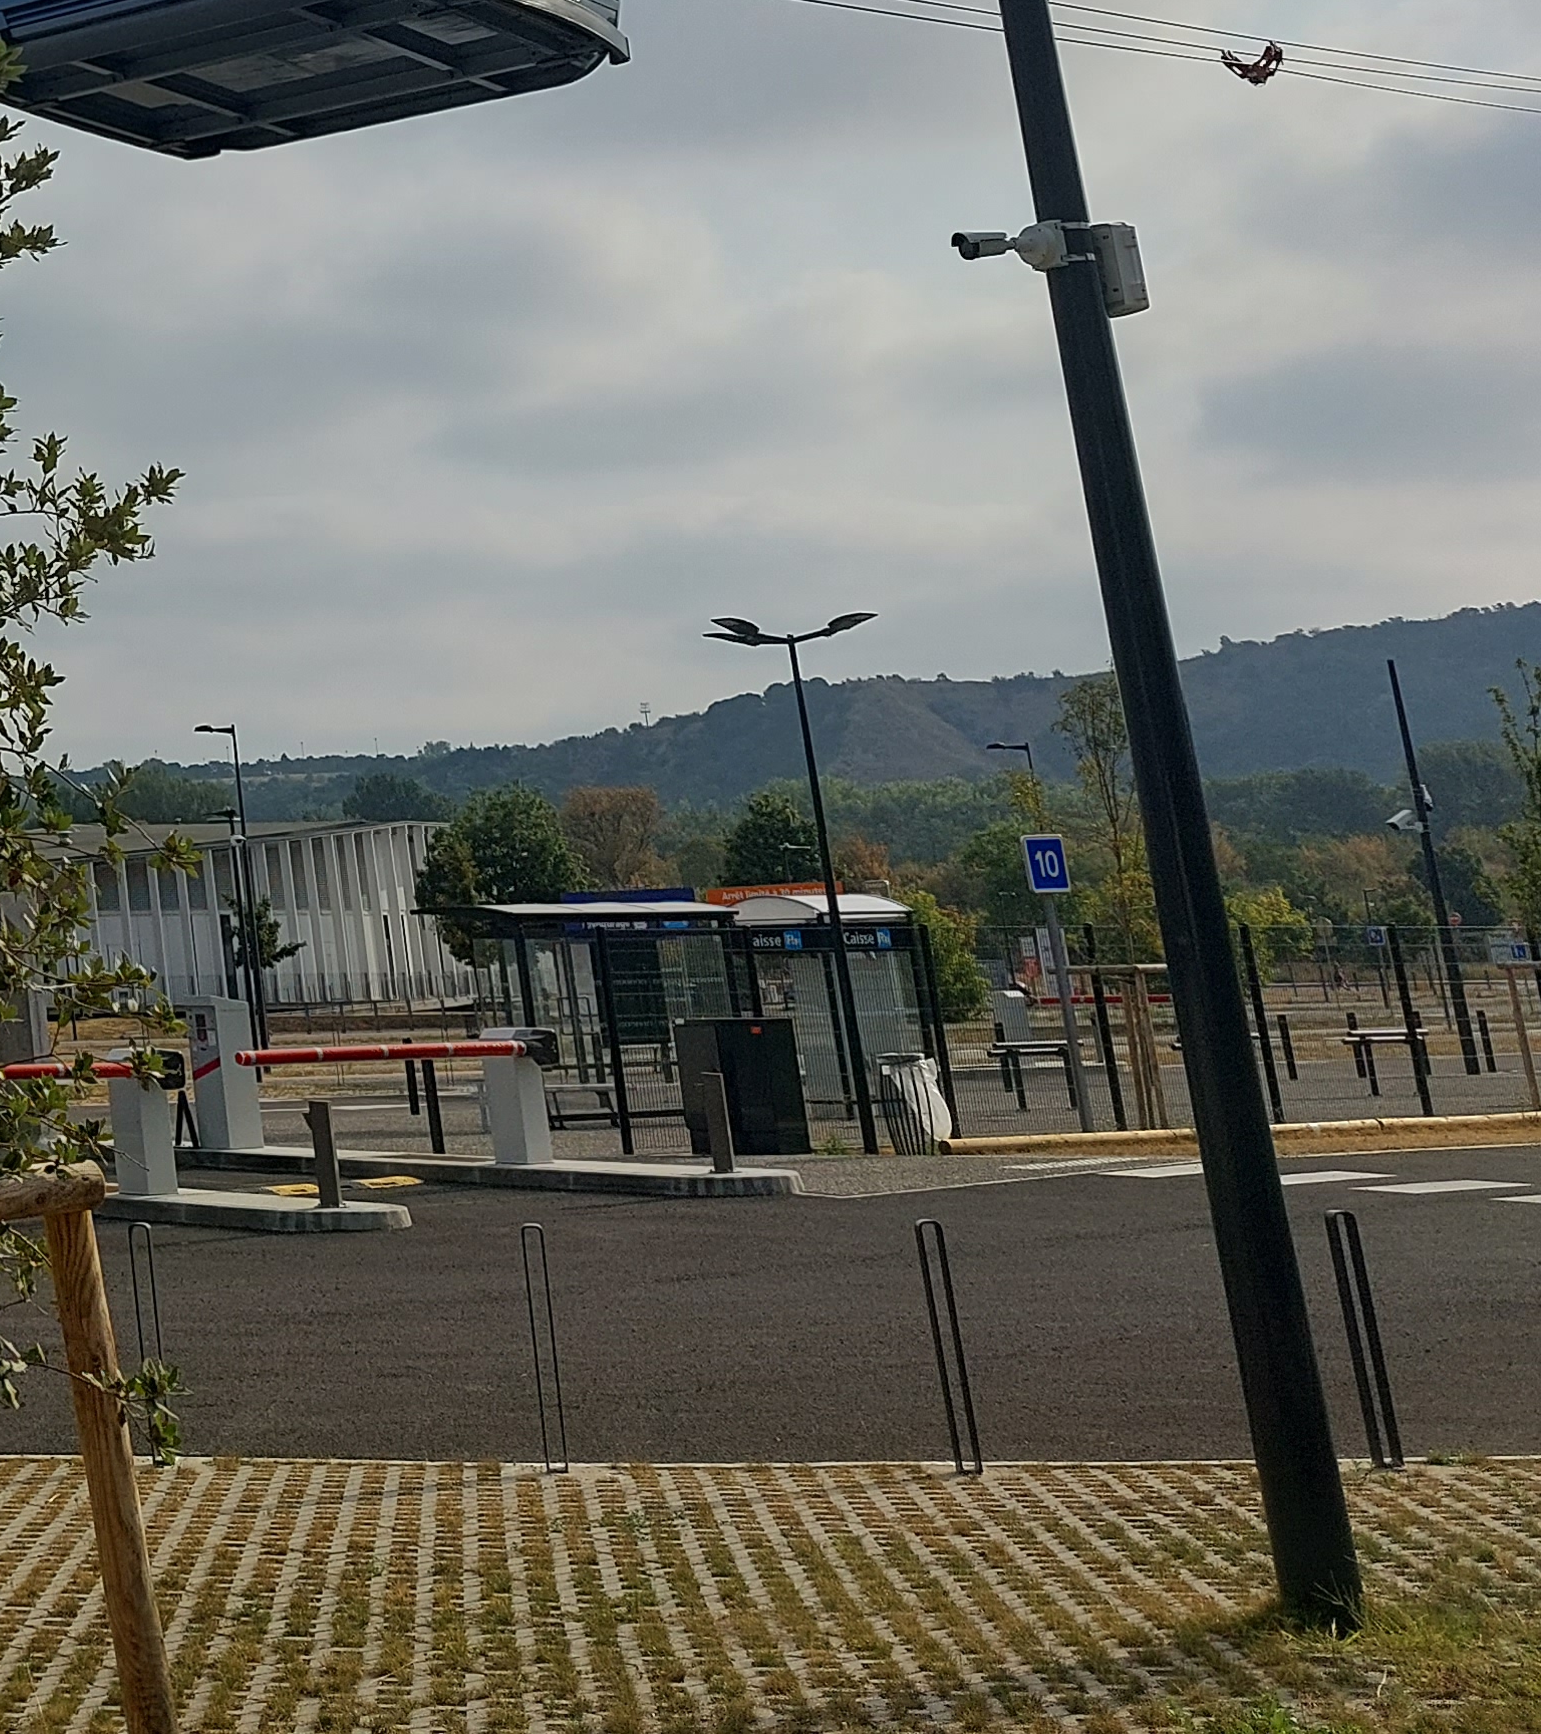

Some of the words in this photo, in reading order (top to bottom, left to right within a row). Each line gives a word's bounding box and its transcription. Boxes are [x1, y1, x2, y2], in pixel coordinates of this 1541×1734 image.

[1034, 850, 1059, 878] 10
[752, 933, 781, 947] aisse
[843, 931, 875, 945] Caisse
